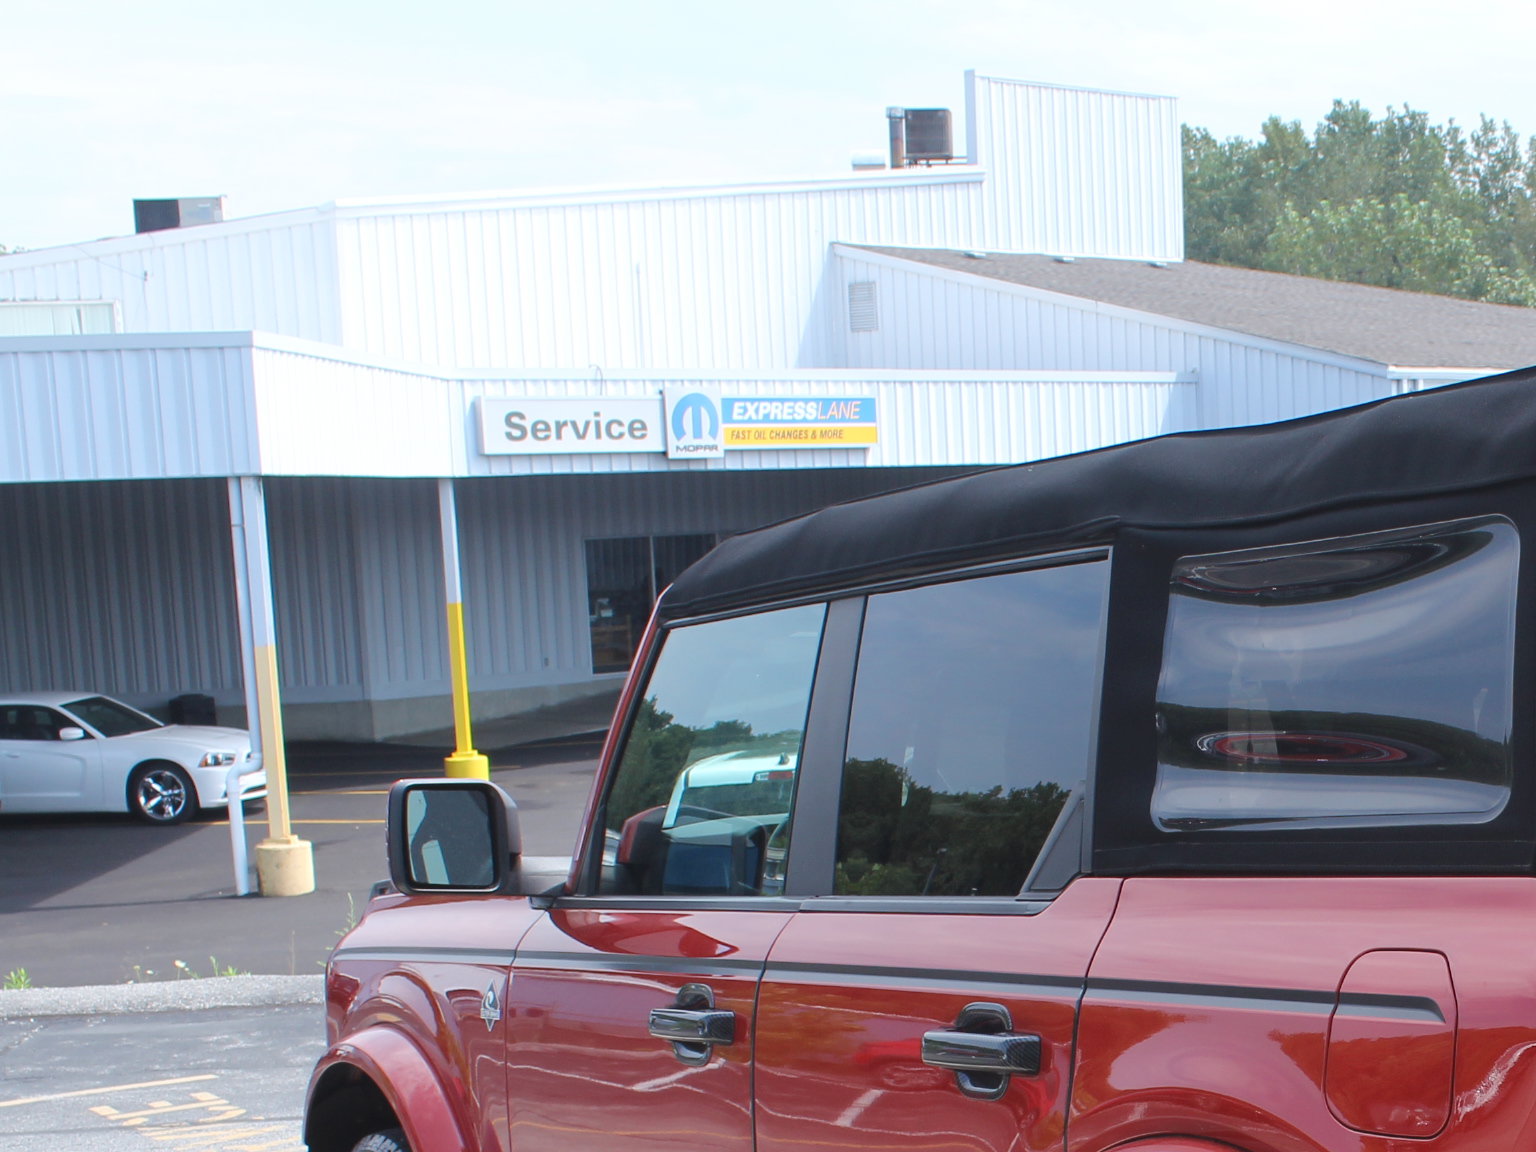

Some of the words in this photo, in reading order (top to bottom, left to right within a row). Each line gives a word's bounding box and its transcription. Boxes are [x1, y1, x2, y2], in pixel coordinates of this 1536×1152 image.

[504, 411, 648, 442] Service
[730, 430, 752, 441] FAST
[754, 430, 766, 440] OIL
[769, 430, 808, 440] CHANGES
[811, 429, 817, 439] &
[819, 429, 844, 439] MORE
[675, 444, 719, 453] MOPAR
